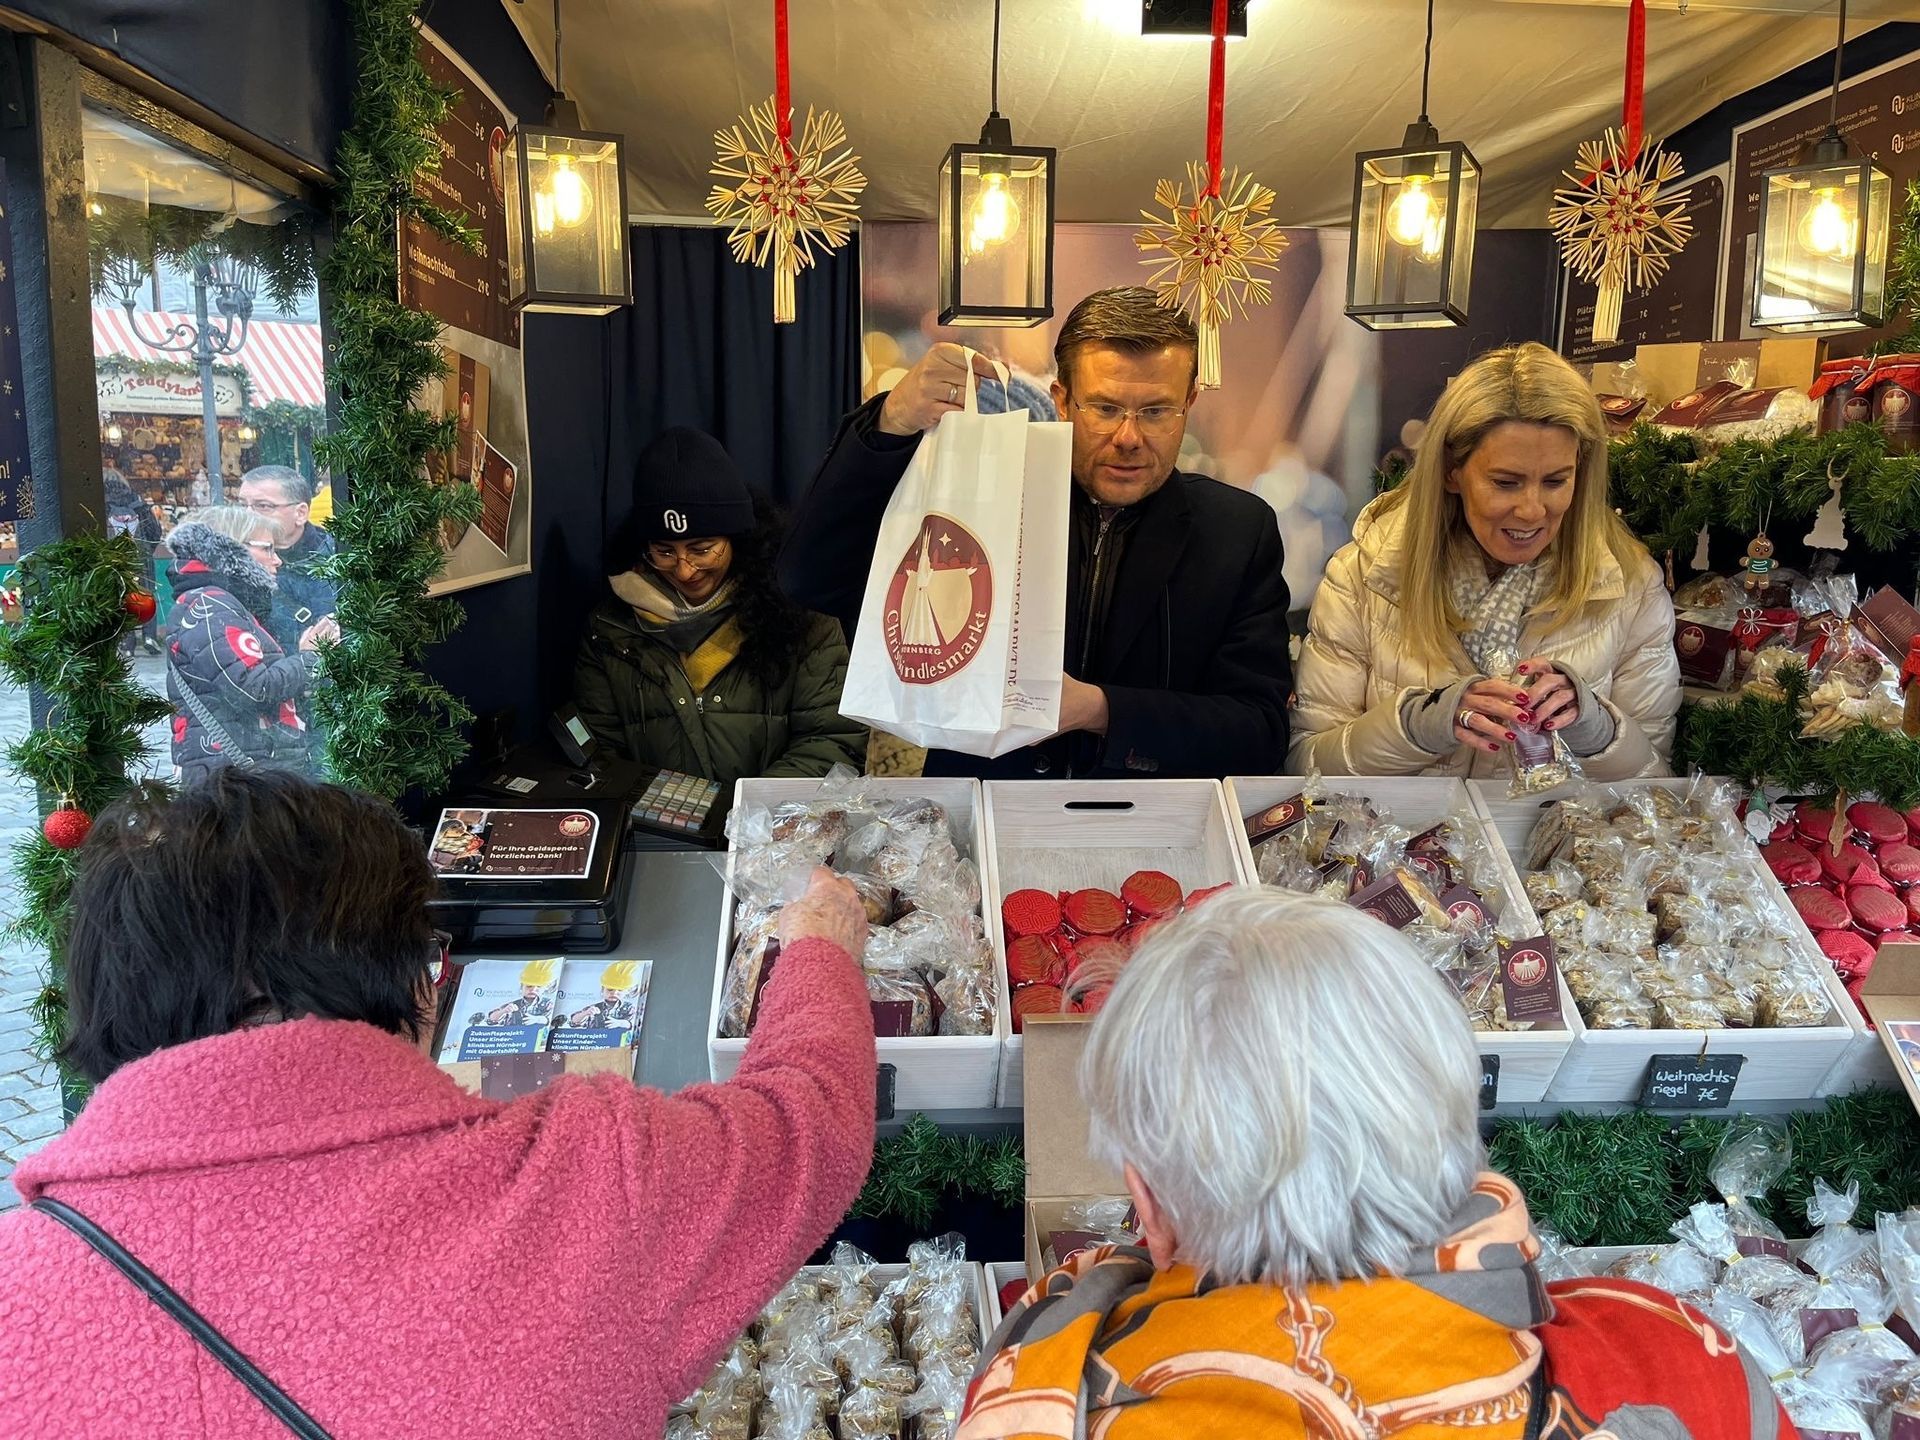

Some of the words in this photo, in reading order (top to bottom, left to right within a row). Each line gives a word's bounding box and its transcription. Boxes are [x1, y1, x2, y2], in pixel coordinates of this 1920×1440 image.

[407, 242, 456, 280] Weihnachtsbox
[124, 376, 203, 396] Teddyland
[886, 610, 987, 680] Chrisindlesmarkt
[527, 845, 578, 853] Geldspende
[1655, 1070, 1737, 1084] Weihnachts-
[1652, 1083, 1688, 1098] riegel
[1697, 1087, 1719, 1102] 7€
